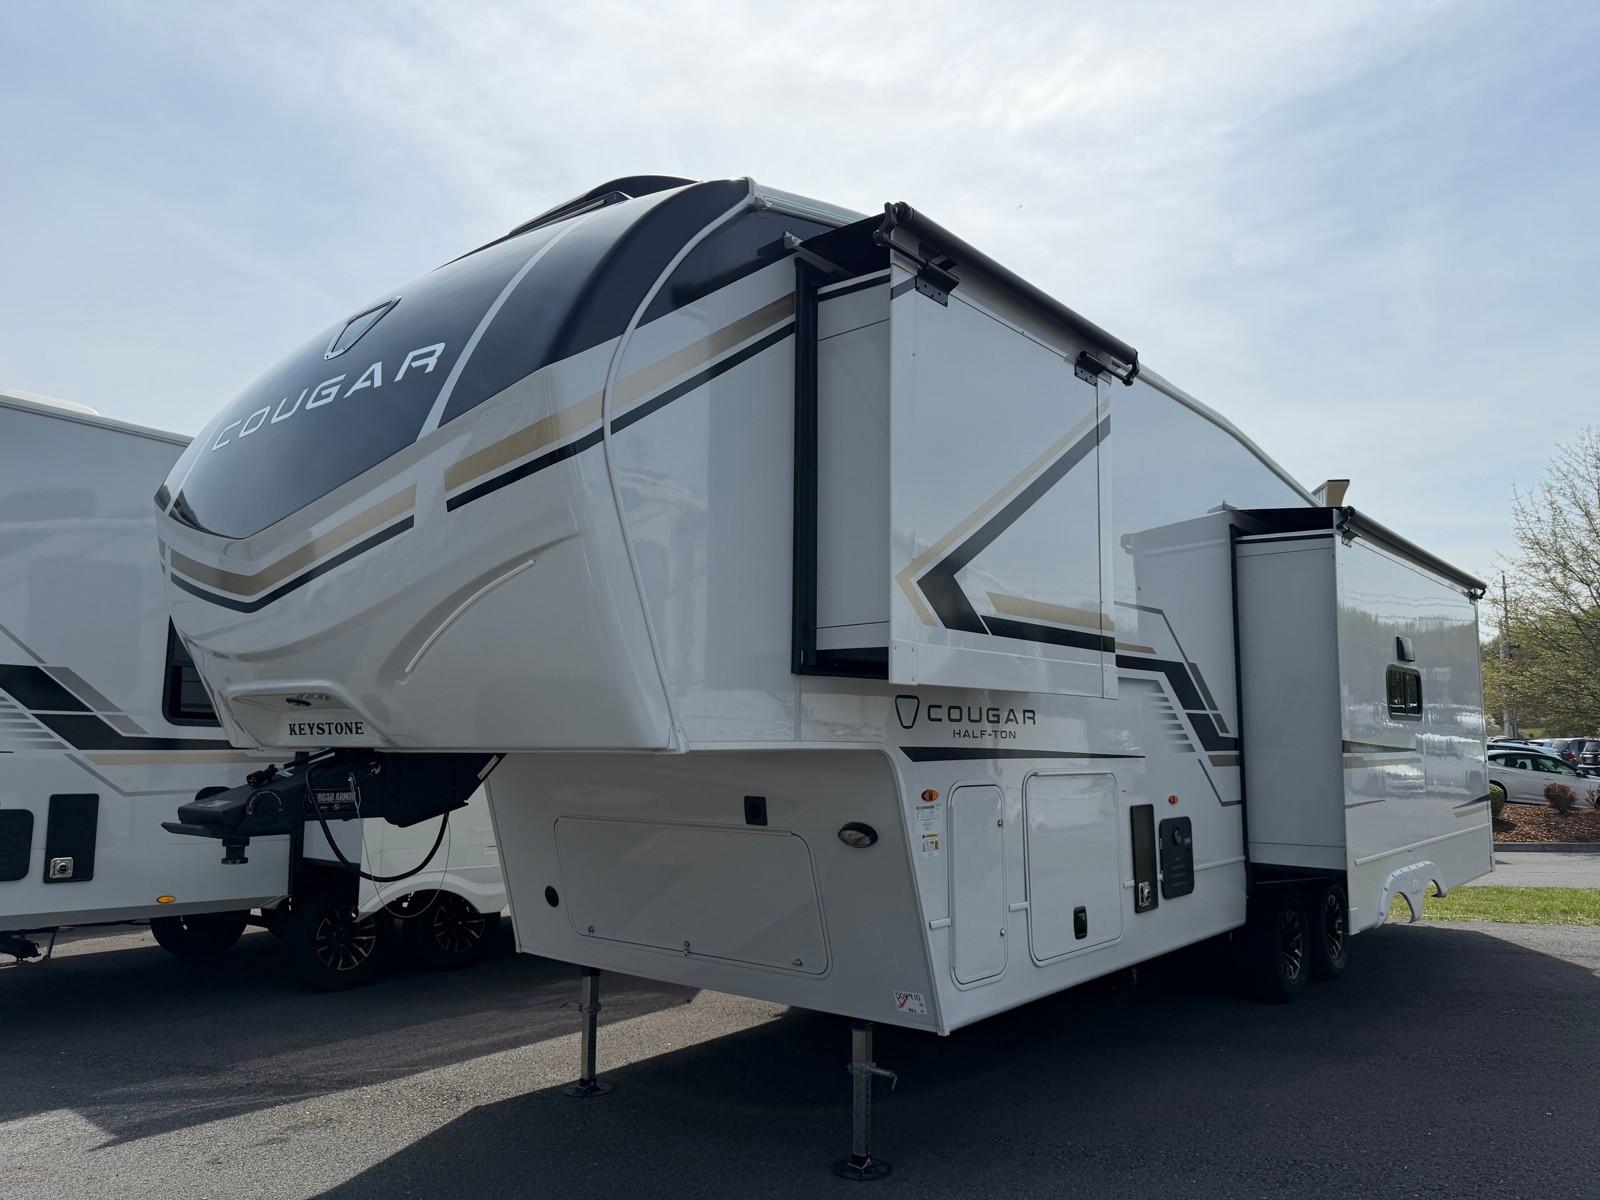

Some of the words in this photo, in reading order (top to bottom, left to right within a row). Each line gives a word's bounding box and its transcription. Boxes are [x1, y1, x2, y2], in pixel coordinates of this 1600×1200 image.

[212, 342, 446, 451] COUGAR
[927, 704, 1036, 725] COUGAR
[288, 721, 365, 736] KEYSTONE
[952, 729, 1017, 739] HALF-TON
